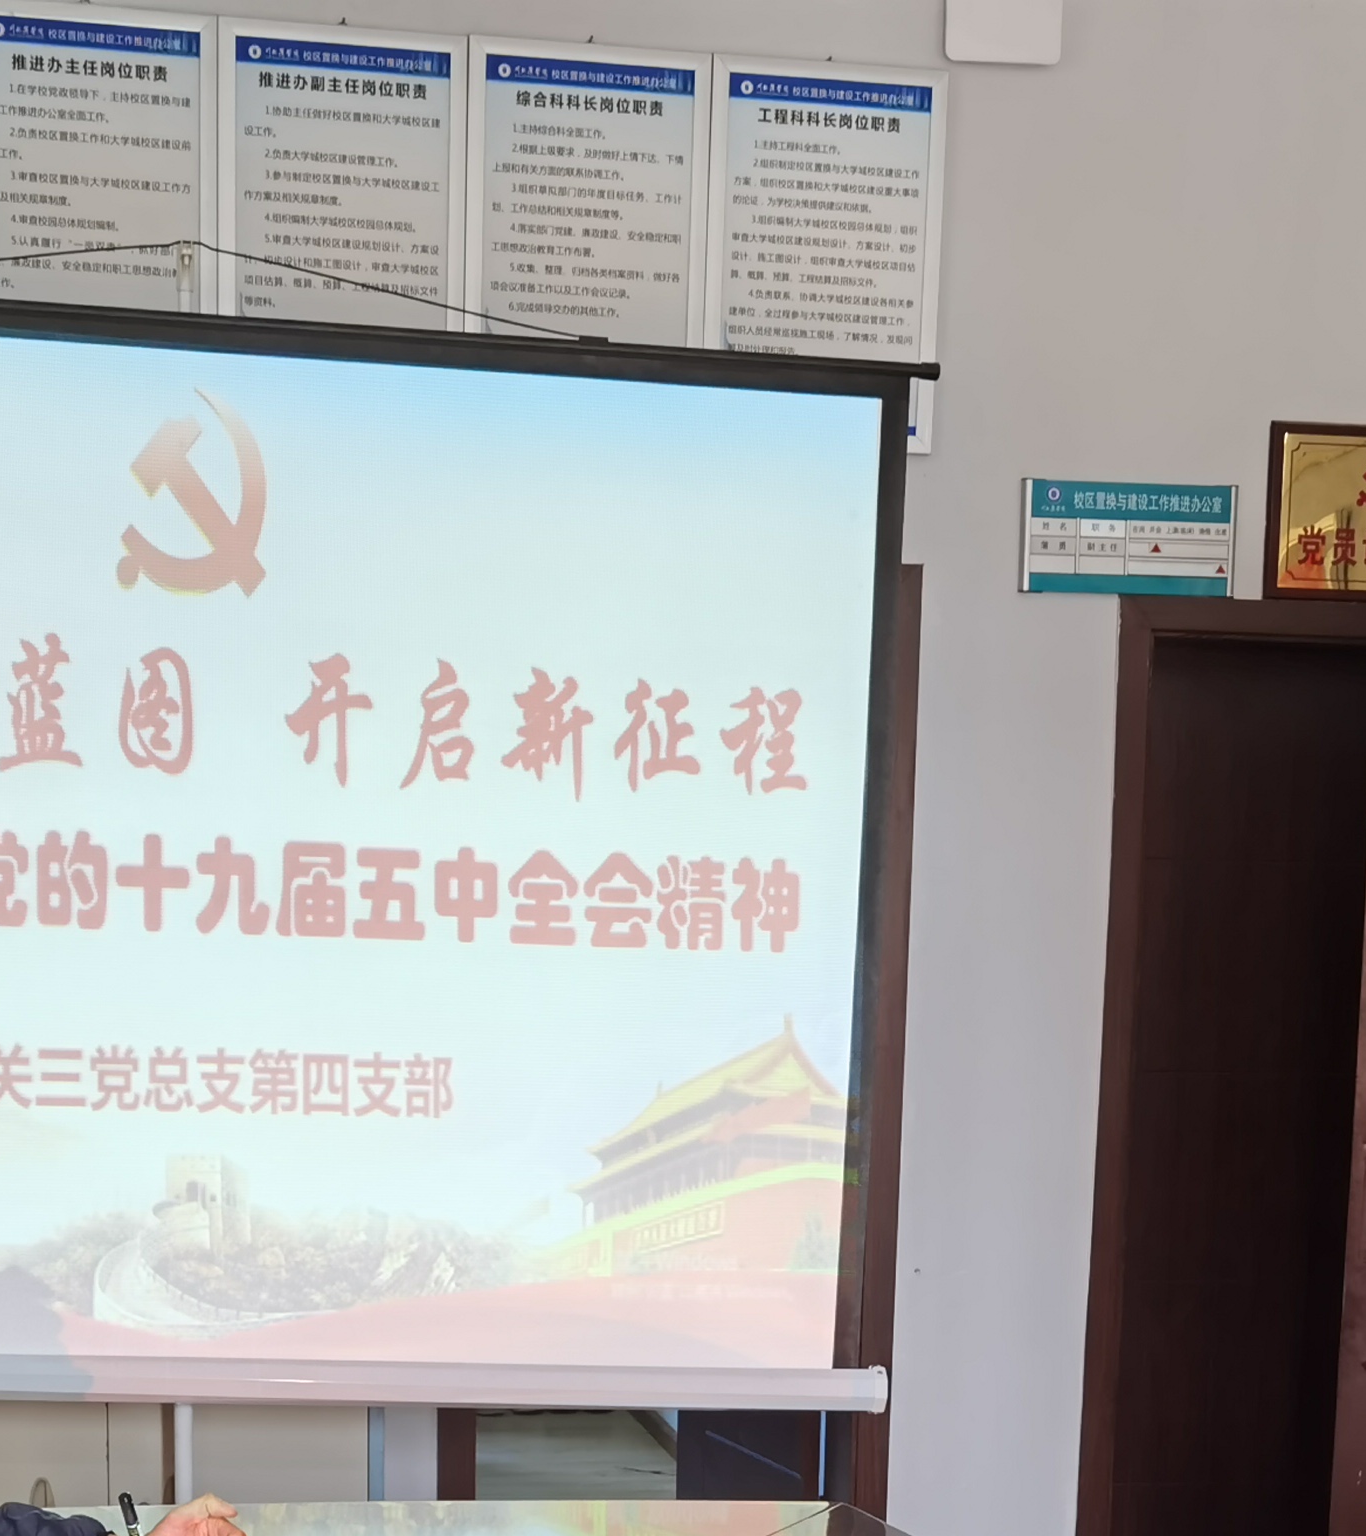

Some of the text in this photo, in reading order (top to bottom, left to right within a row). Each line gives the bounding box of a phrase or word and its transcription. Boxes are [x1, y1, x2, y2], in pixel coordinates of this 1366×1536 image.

[12, 54, 168, 82] 推进办主任岗位职责
[259, 71, 427, 100] 推进办副主任岗位职责
[516, 91, 664, 116] 综合科科长岗位职责
[758, 108, 901, 133] 工程科科长岗位职责
[1074, 491, 1222, 513] 校区置换与建设工作推进办公室
[284, 651, 810, 801] 开启新征程
